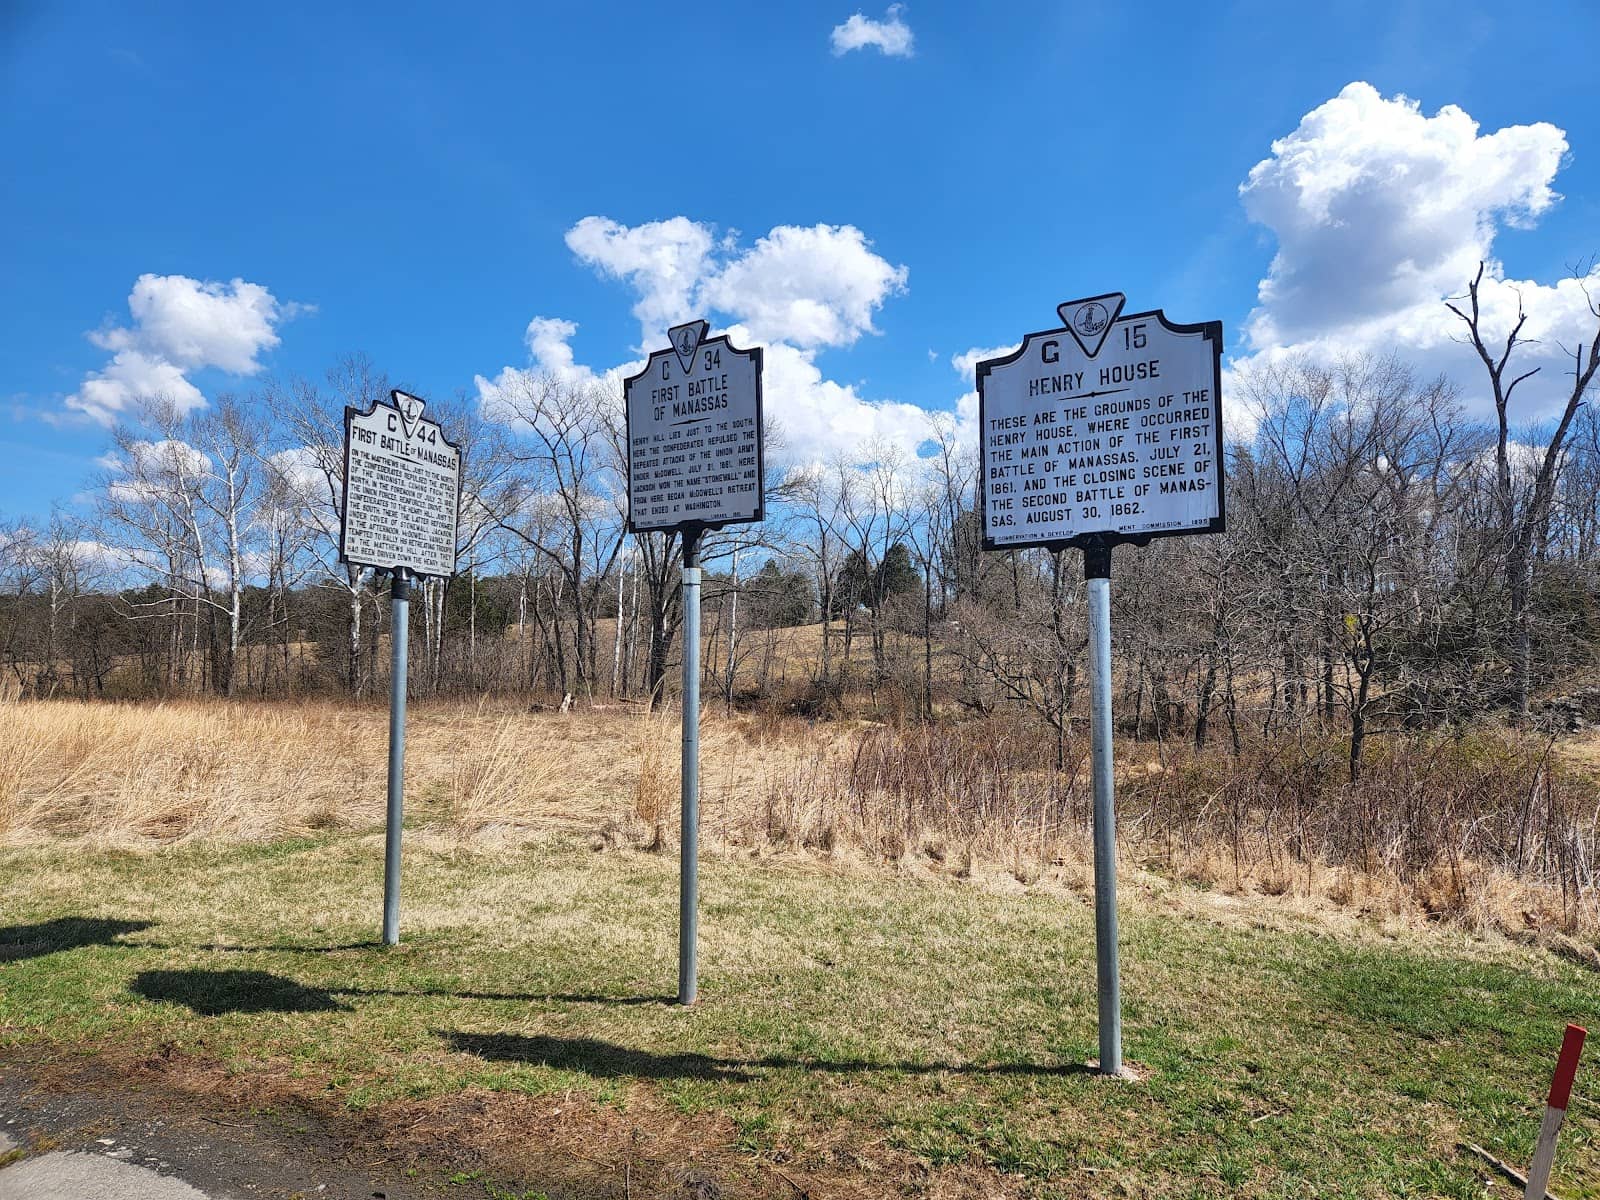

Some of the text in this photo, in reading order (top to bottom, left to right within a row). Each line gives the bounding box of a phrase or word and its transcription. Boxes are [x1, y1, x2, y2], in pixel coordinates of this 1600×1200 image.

[1042, 324, 1147, 364] G 15
[662, 349, 720, 380] C 34
[1029, 359, 1160, 397] HENRY HOUSE
[651, 373, 727, 405] FIRST BATTLE
[654, 392, 727, 421] OF MANASSAS
[990, 389, 1208, 431] THESE ARE THE GROUNDS OF THE
[388, 414, 436, 446] C 44
[990, 431, 1025, 446] HENRY
[1087, 417, 1129, 434] WHERE
[1140, 407, 1209, 427] OCCURRED
[990, 424, 1209, 462] THE MAIN ACTION OF THE FIRST
[352, 425, 456, 470] FIRST BATTLE OF MANASSAS
[990, 463, 1034, 478] BATTLE
[1044, 460, 1058, 472] OF
[1149, 445, 1180, 460] JULY
[1023, 478, 1045, 491] AND
[1053, 475, 1076, 488] THE
[1083, 468, 1135, 484] CLOSING
[1143, 462, 1184, 478] SCENE
[1194, 460, 1211, 472] OF
[991, 477, 1211, 511] THE SECOND BATTLE OF MANAS-
[1026, 508, 1071, 524] AUGUST
[1142, 521, 1182, 529] COMMISSION
